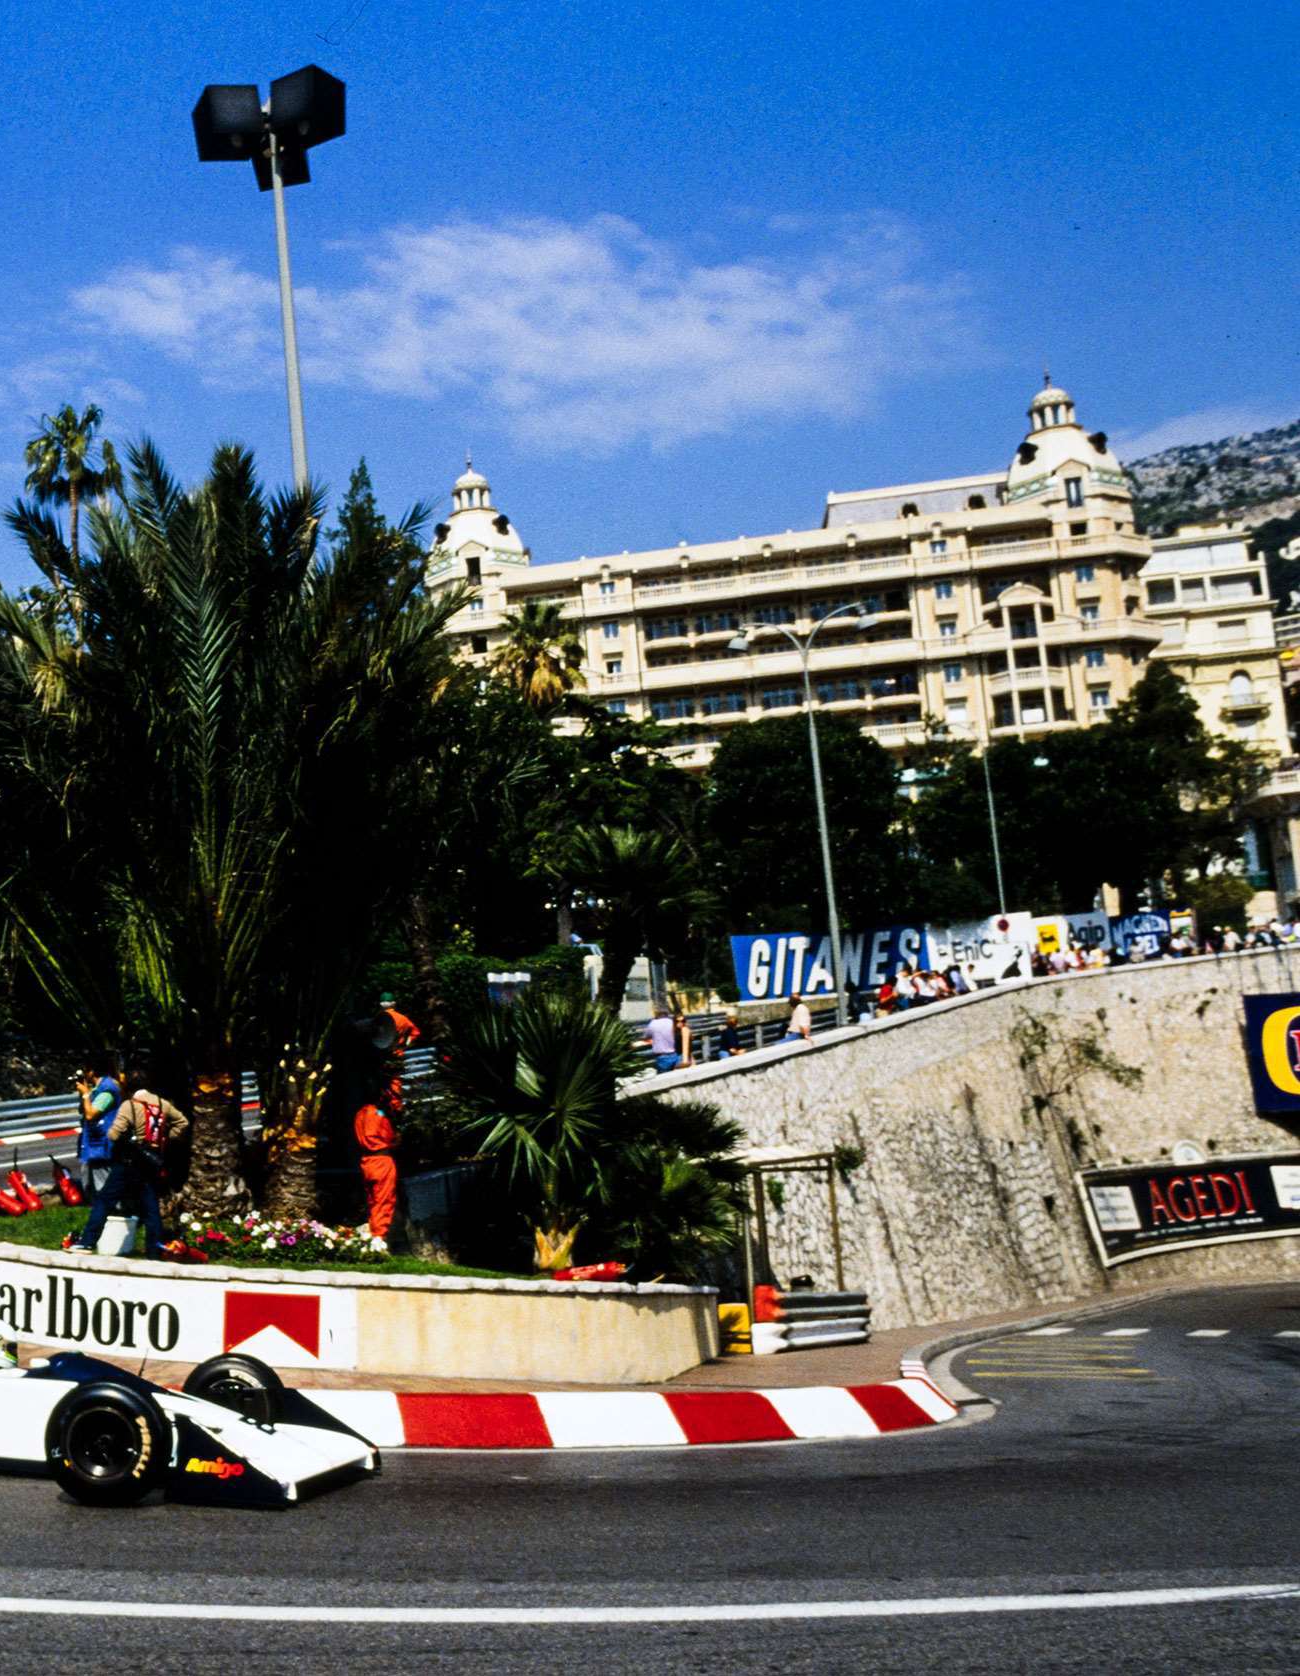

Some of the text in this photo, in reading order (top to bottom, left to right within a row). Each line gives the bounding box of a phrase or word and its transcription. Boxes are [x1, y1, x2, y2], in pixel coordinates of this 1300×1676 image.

[748, 928, 920, 998] GITANES
[951, 939, 996, 963] EniC
[1148, 1170, 1256, 1225] AGEDI
[185, 1456, 245, 1479] Amigo
